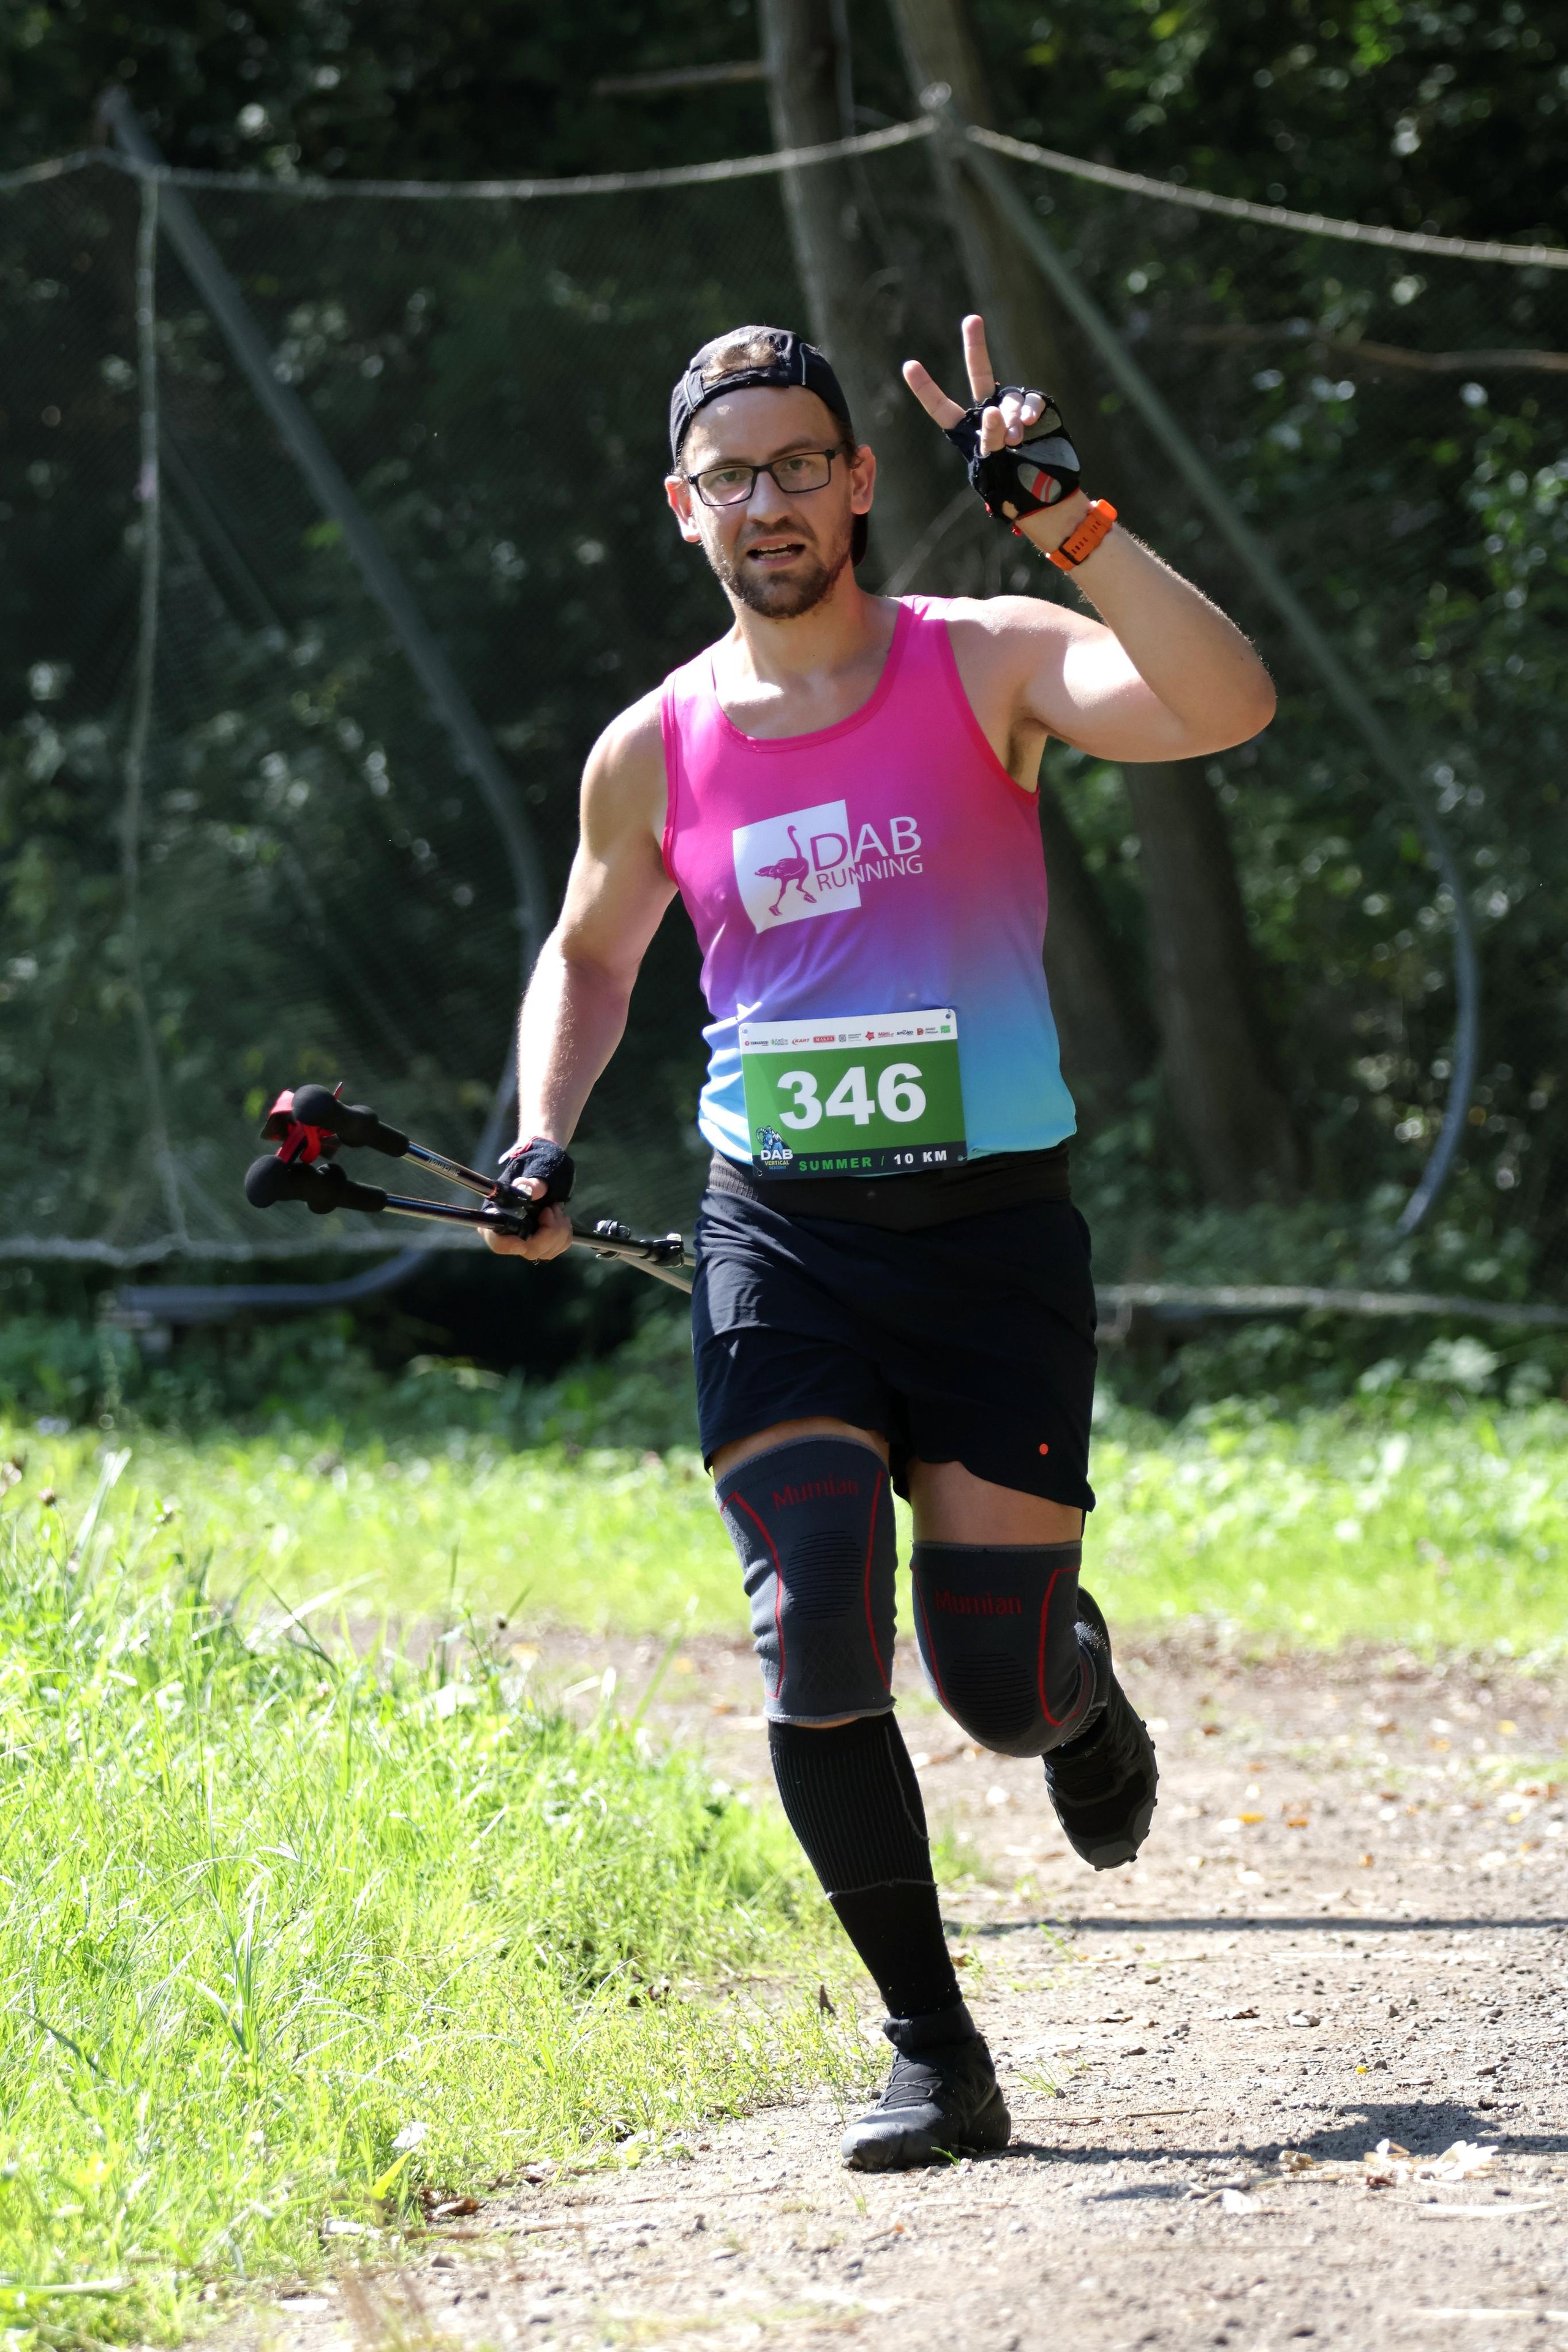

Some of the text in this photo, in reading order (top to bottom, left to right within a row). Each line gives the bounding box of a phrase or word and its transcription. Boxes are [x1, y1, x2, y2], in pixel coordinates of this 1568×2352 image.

[810, 816, 922, 872] DAB
[816, 854, 924, 891] RUNNING
[777, 1063, 927, 1130] 346
[761, 1148, 793, 1161] DAB
[799, 1156, 873, 1172] SUMMER
[894, 1153, 914, 1165] 10
[923, 1150, 947, 1163] KM
[771, 1475, 859, 1513] Mumian
[934, 1589, 1022, 1617] Mumian
